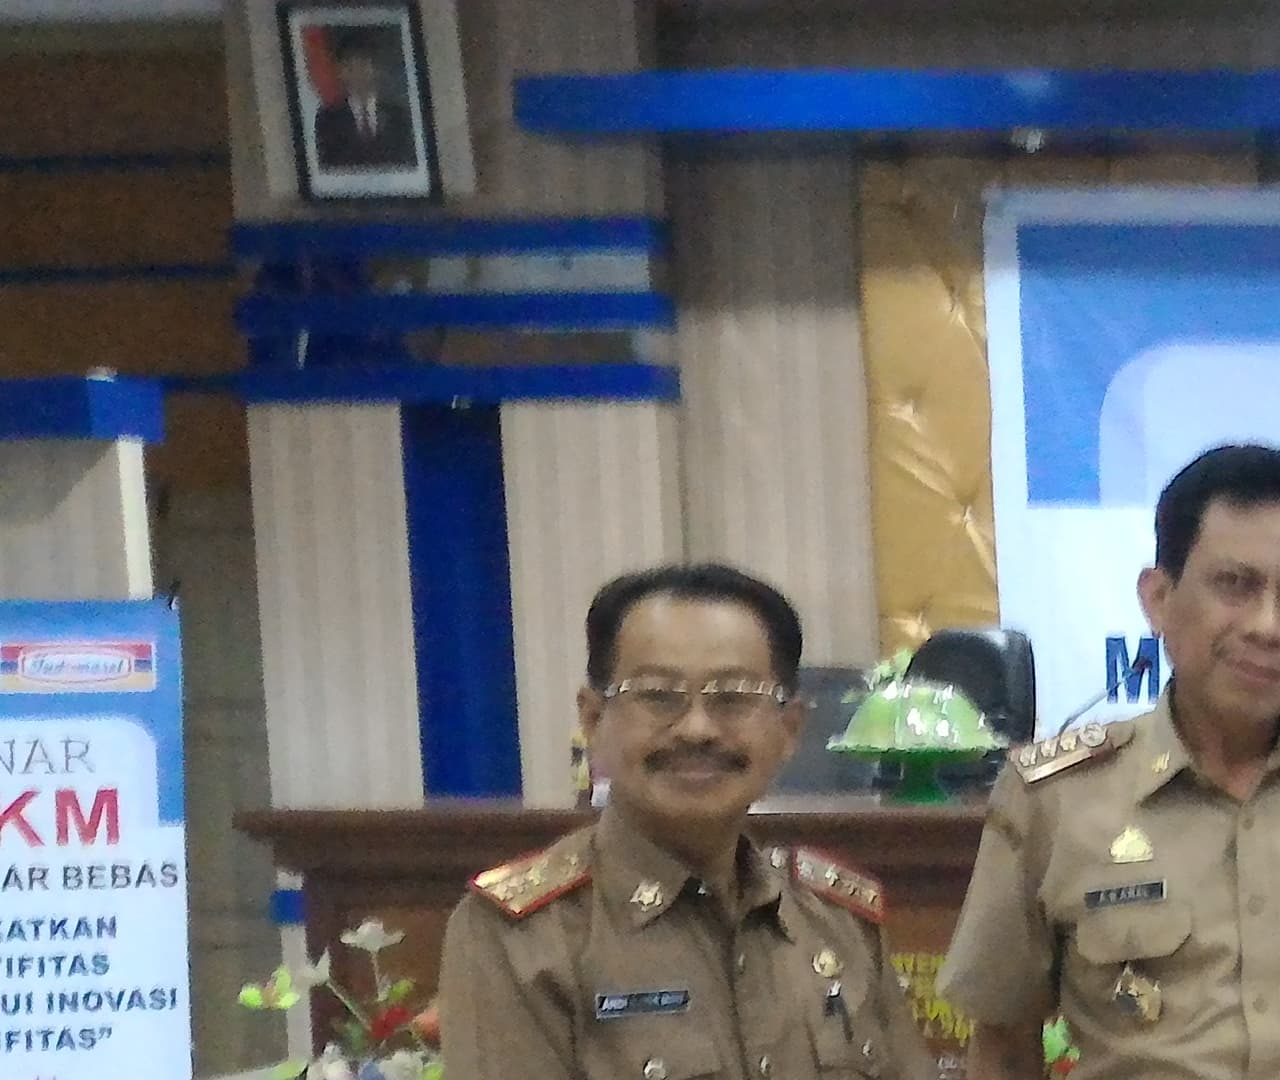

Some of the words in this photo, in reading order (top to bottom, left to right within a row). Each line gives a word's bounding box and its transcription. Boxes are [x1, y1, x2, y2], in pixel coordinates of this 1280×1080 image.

[62, 860, 179, 891] BEBAS
[0, 915, 118, 942] ATKAN
[0, 953, 110, 979] IFITAS
[46, 988, 178, 1014] INOVASI
